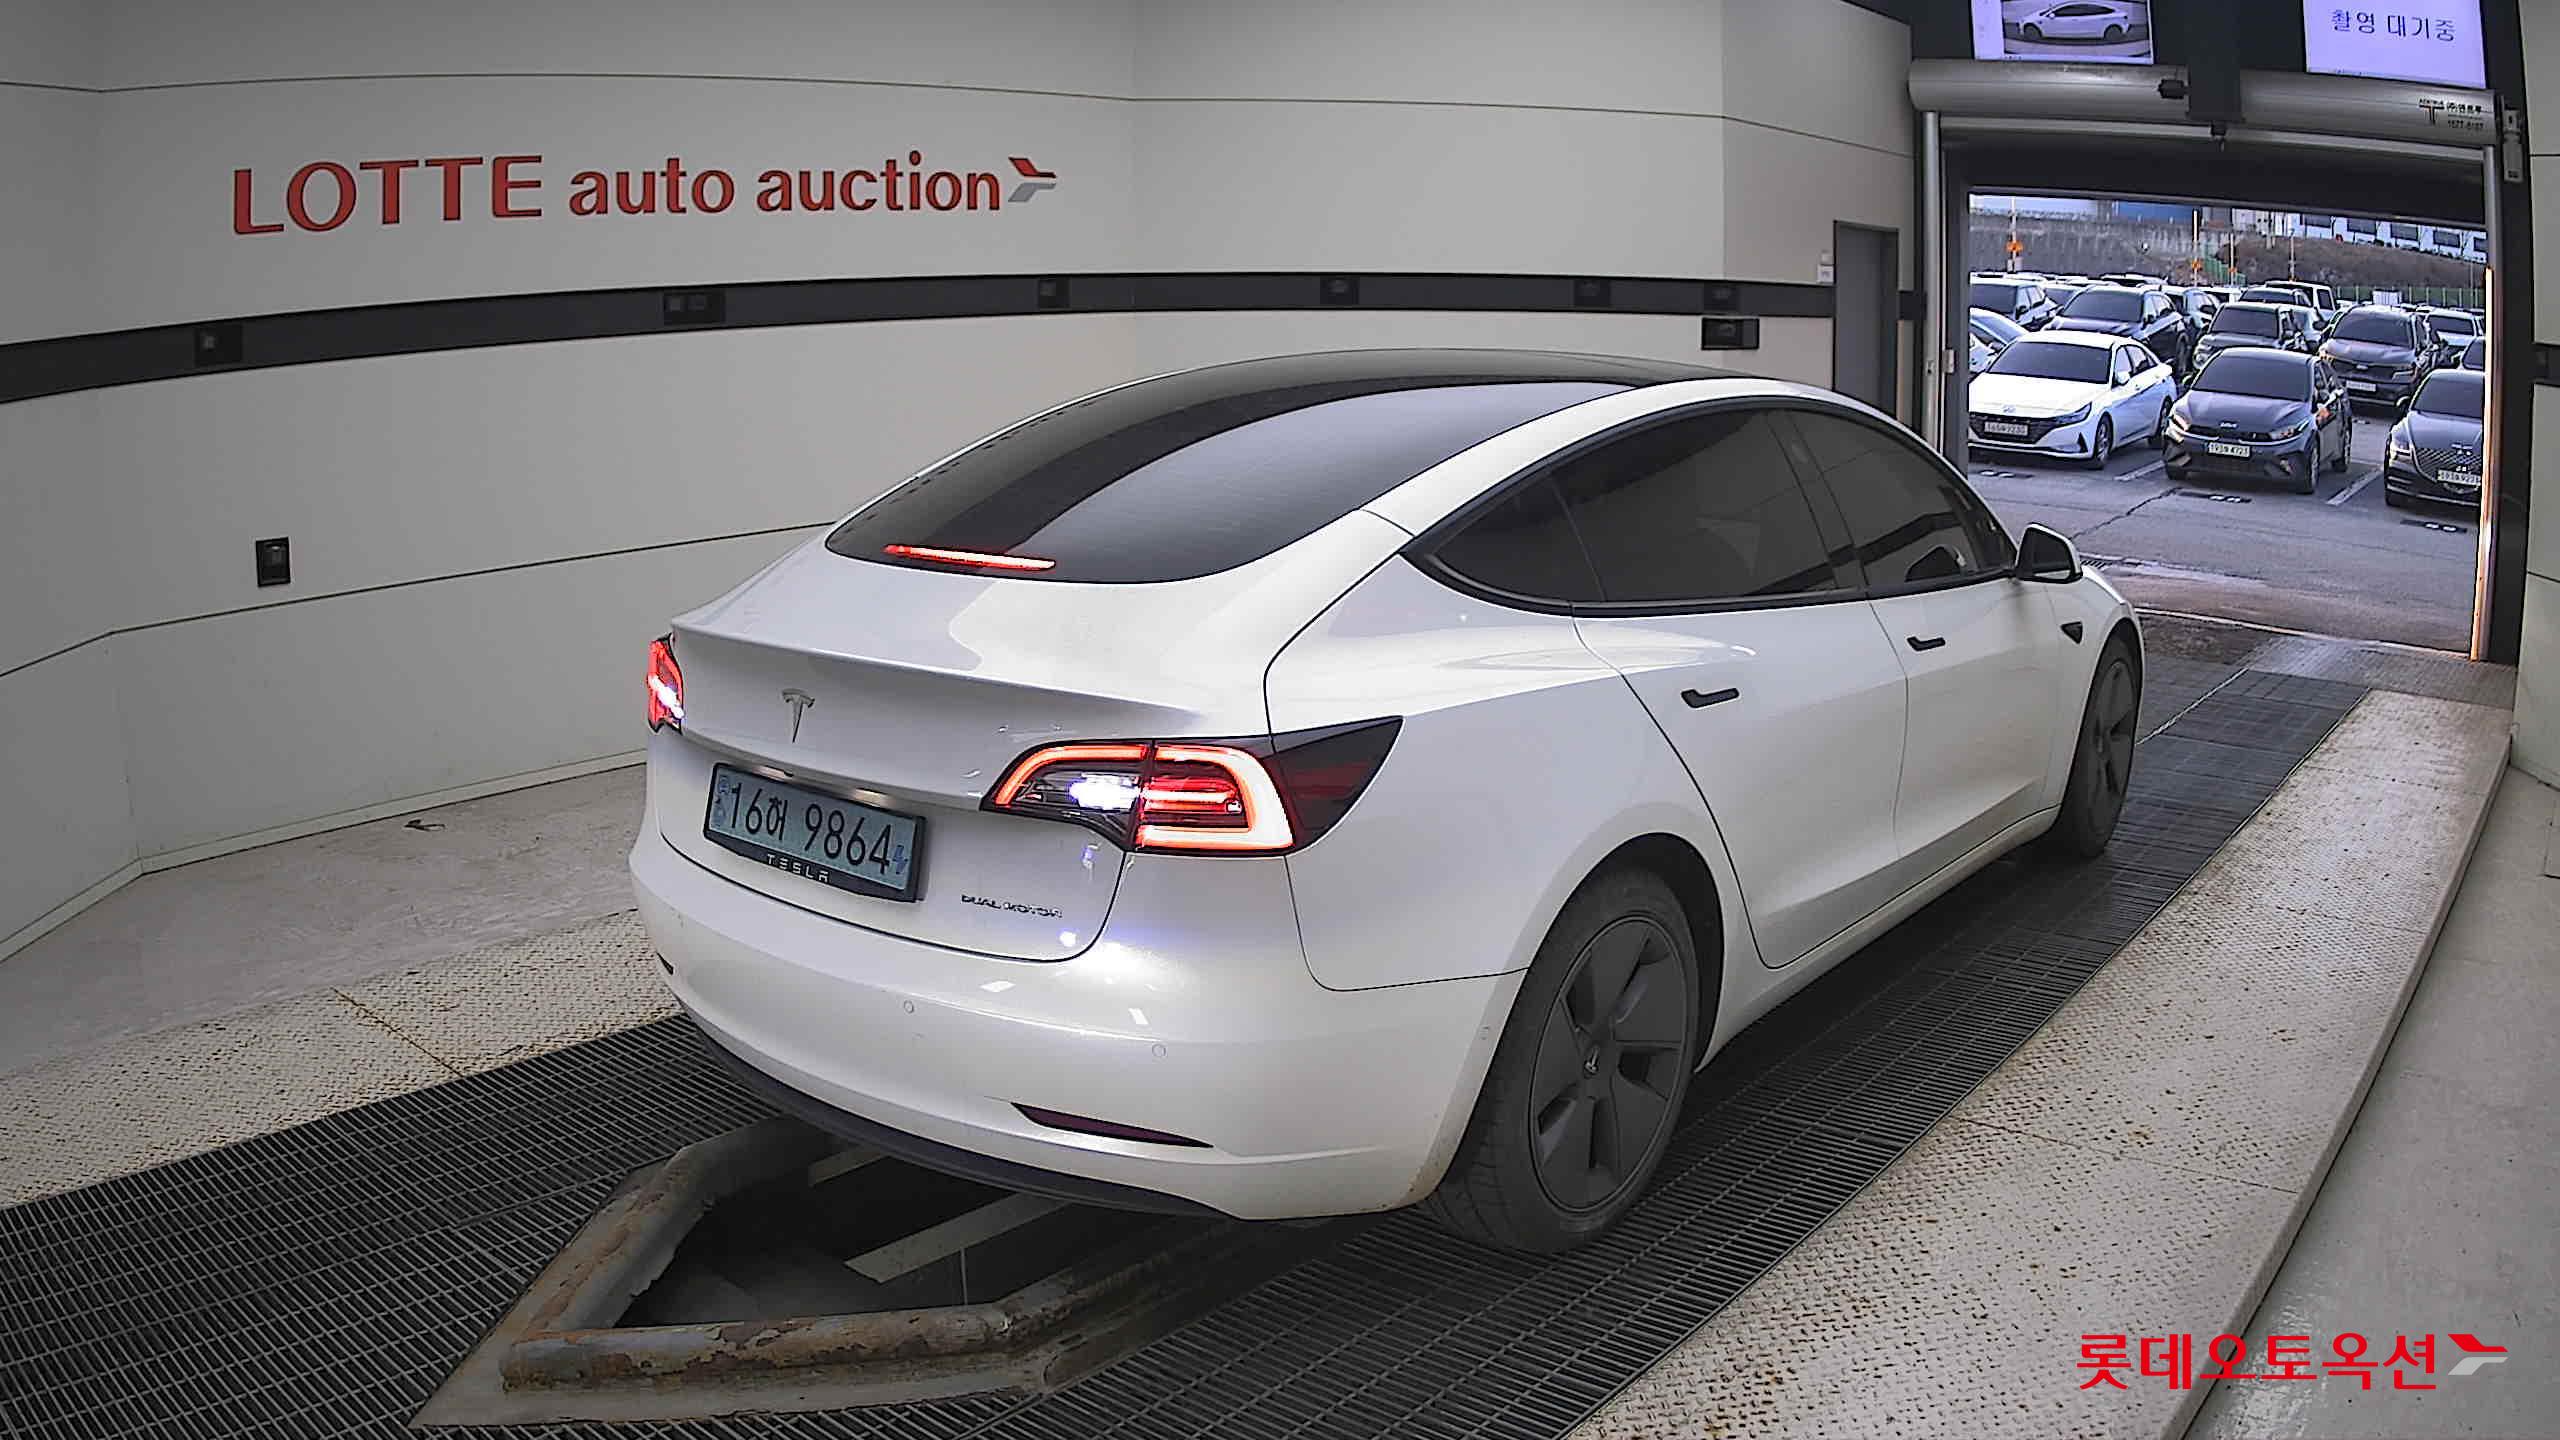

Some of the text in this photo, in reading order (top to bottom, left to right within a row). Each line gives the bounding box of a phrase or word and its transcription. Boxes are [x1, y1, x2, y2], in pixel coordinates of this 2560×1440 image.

[2331, 9, 2455, 42] 촬영 대기중
[233, 150, 1001, 235] LOTTE auto auction
[804, 803, 892, 875] 9864
[767, 853, 830, 883] TESLA
[961, 895, 1001, 909] DUAL
